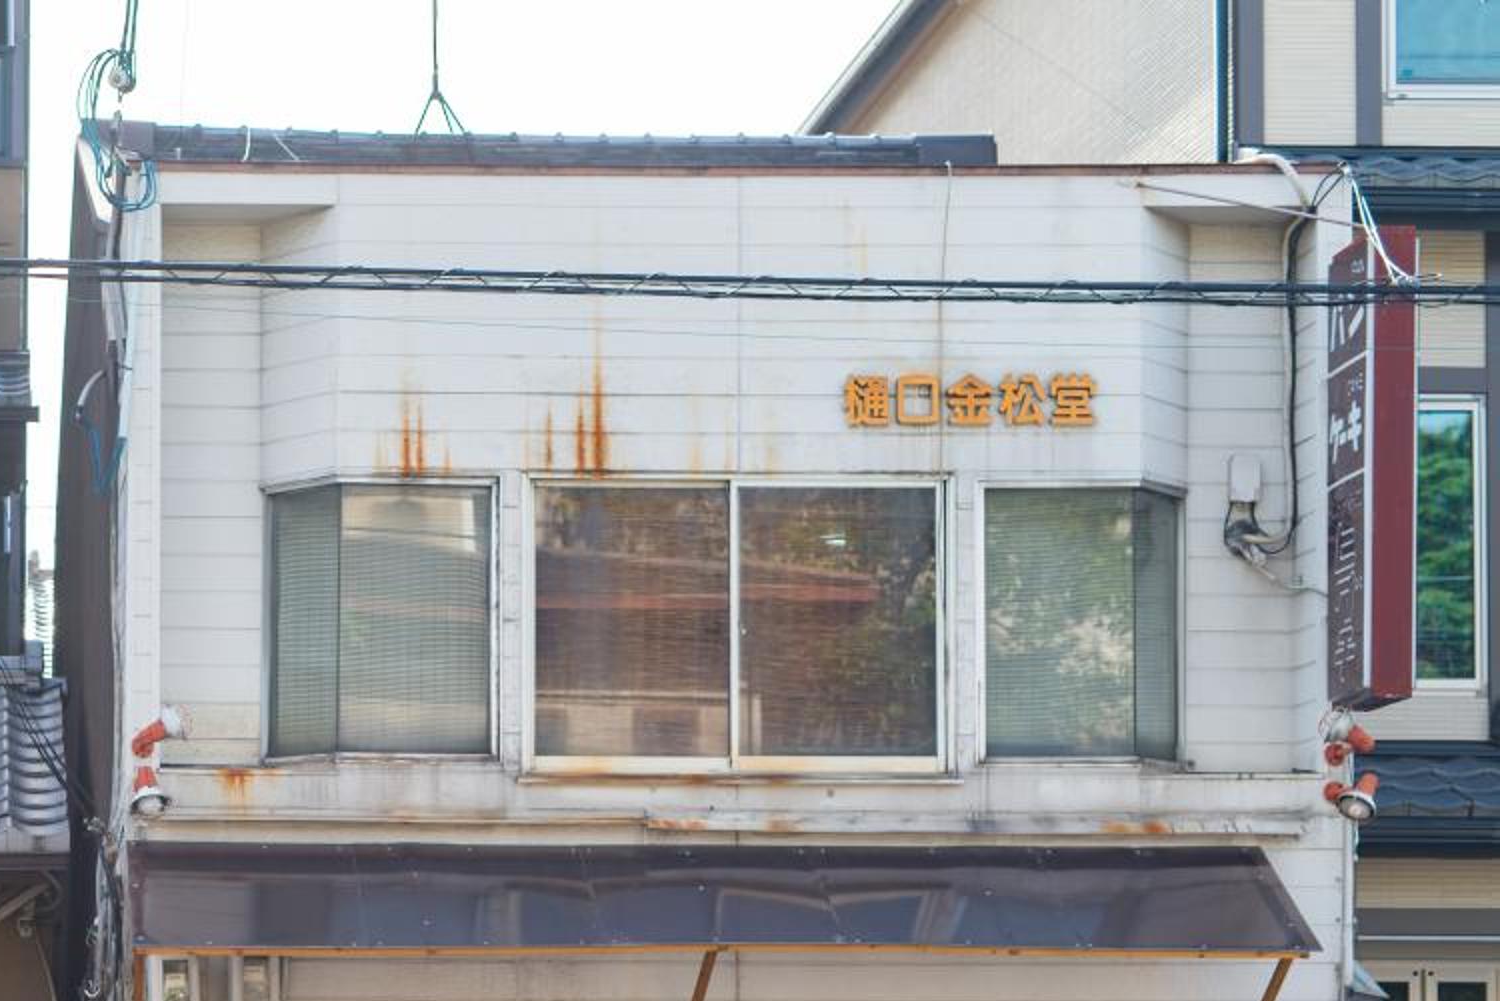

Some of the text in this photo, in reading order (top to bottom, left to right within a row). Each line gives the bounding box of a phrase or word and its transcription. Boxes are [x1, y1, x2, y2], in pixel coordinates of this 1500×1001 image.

[843, 372, 1097, 428] 樋口金松堂
[1329, 400, 1363, 464] ケーキ
